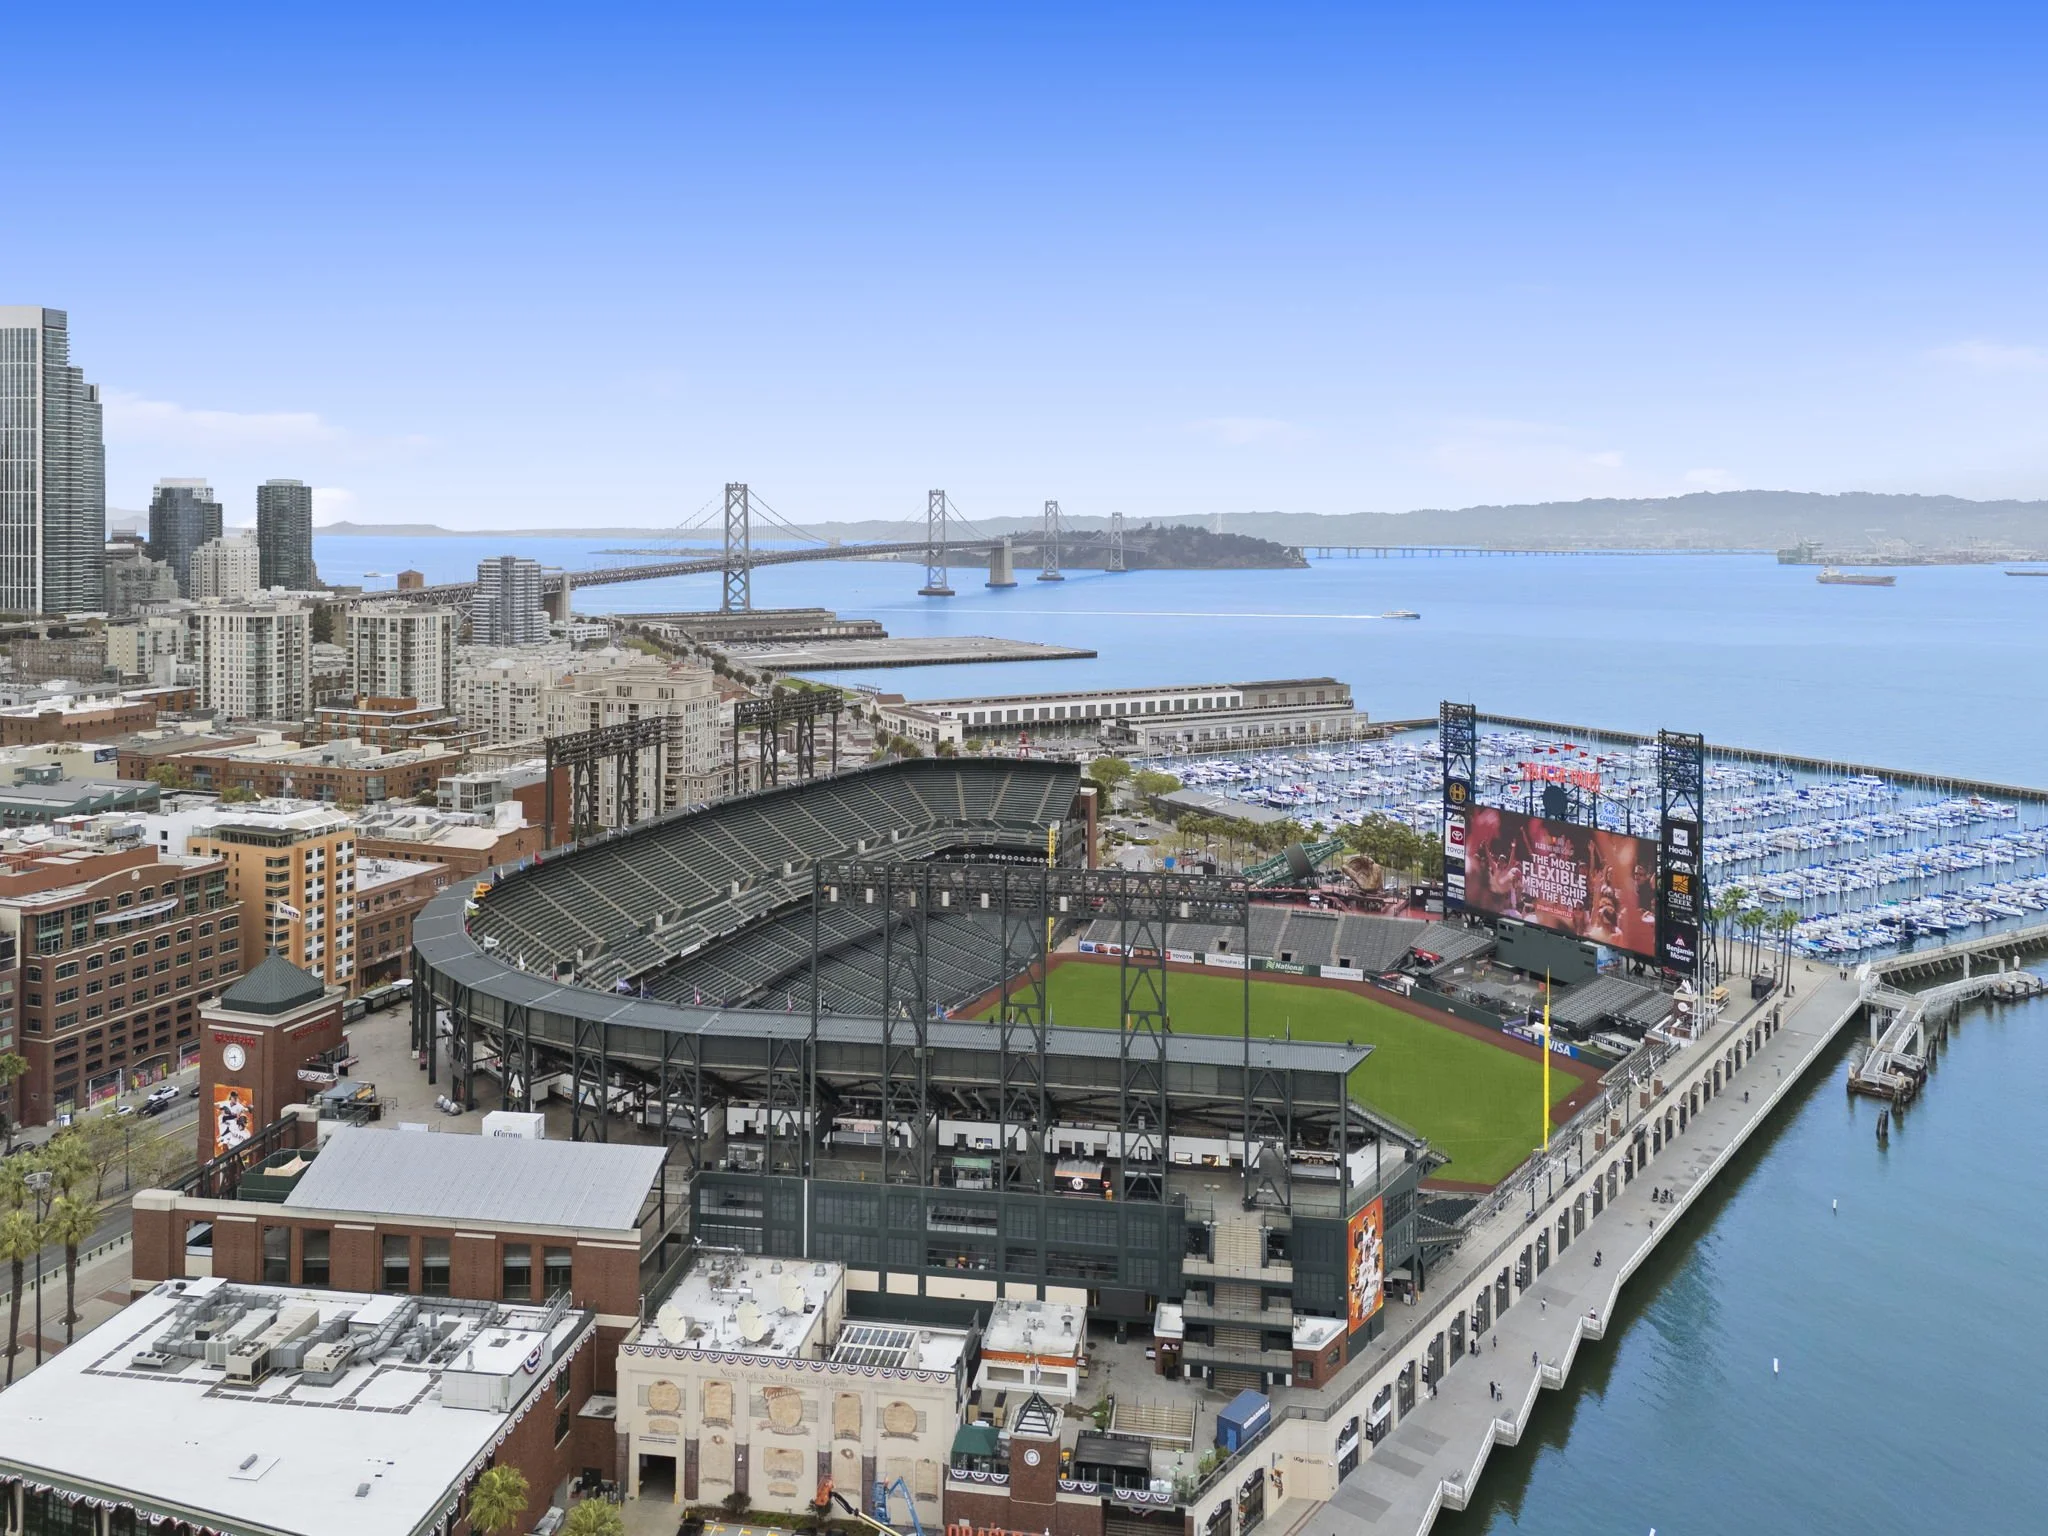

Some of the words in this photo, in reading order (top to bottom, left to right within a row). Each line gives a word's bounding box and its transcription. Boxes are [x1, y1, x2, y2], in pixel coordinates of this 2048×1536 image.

[1600, 814, 1620, 825] coupa
[1447, 846, 1464, 856] TOYOT
[1668, 845, 1693, 857] Health
[1531, 853, 1549, 866] THE
[1551, 857, 1577, 872] MOST
[1522, 860, 1587, 890] FLEXIBLE
[1522, 875, 1587, 900] MEMBERSHIP
[1529, 888, 1539, 898] IN
[1541, 890, 1558, 903] THE
[1560, 895, 1578, 908] BAY
[1667, 890, 1693, 902] CACHE
[1668, 896, 1691, 907] CREEK
[1666, 943, 1694, 957] Benjamin
[1670, 951, 1691, 963] Moore
[1275, 961, 1305, 971] National
[1548, 1040, 1571, 1056] VISA
[494, 1129, 522, 1139] Corona
[720, 1368, 736, 1377] New
